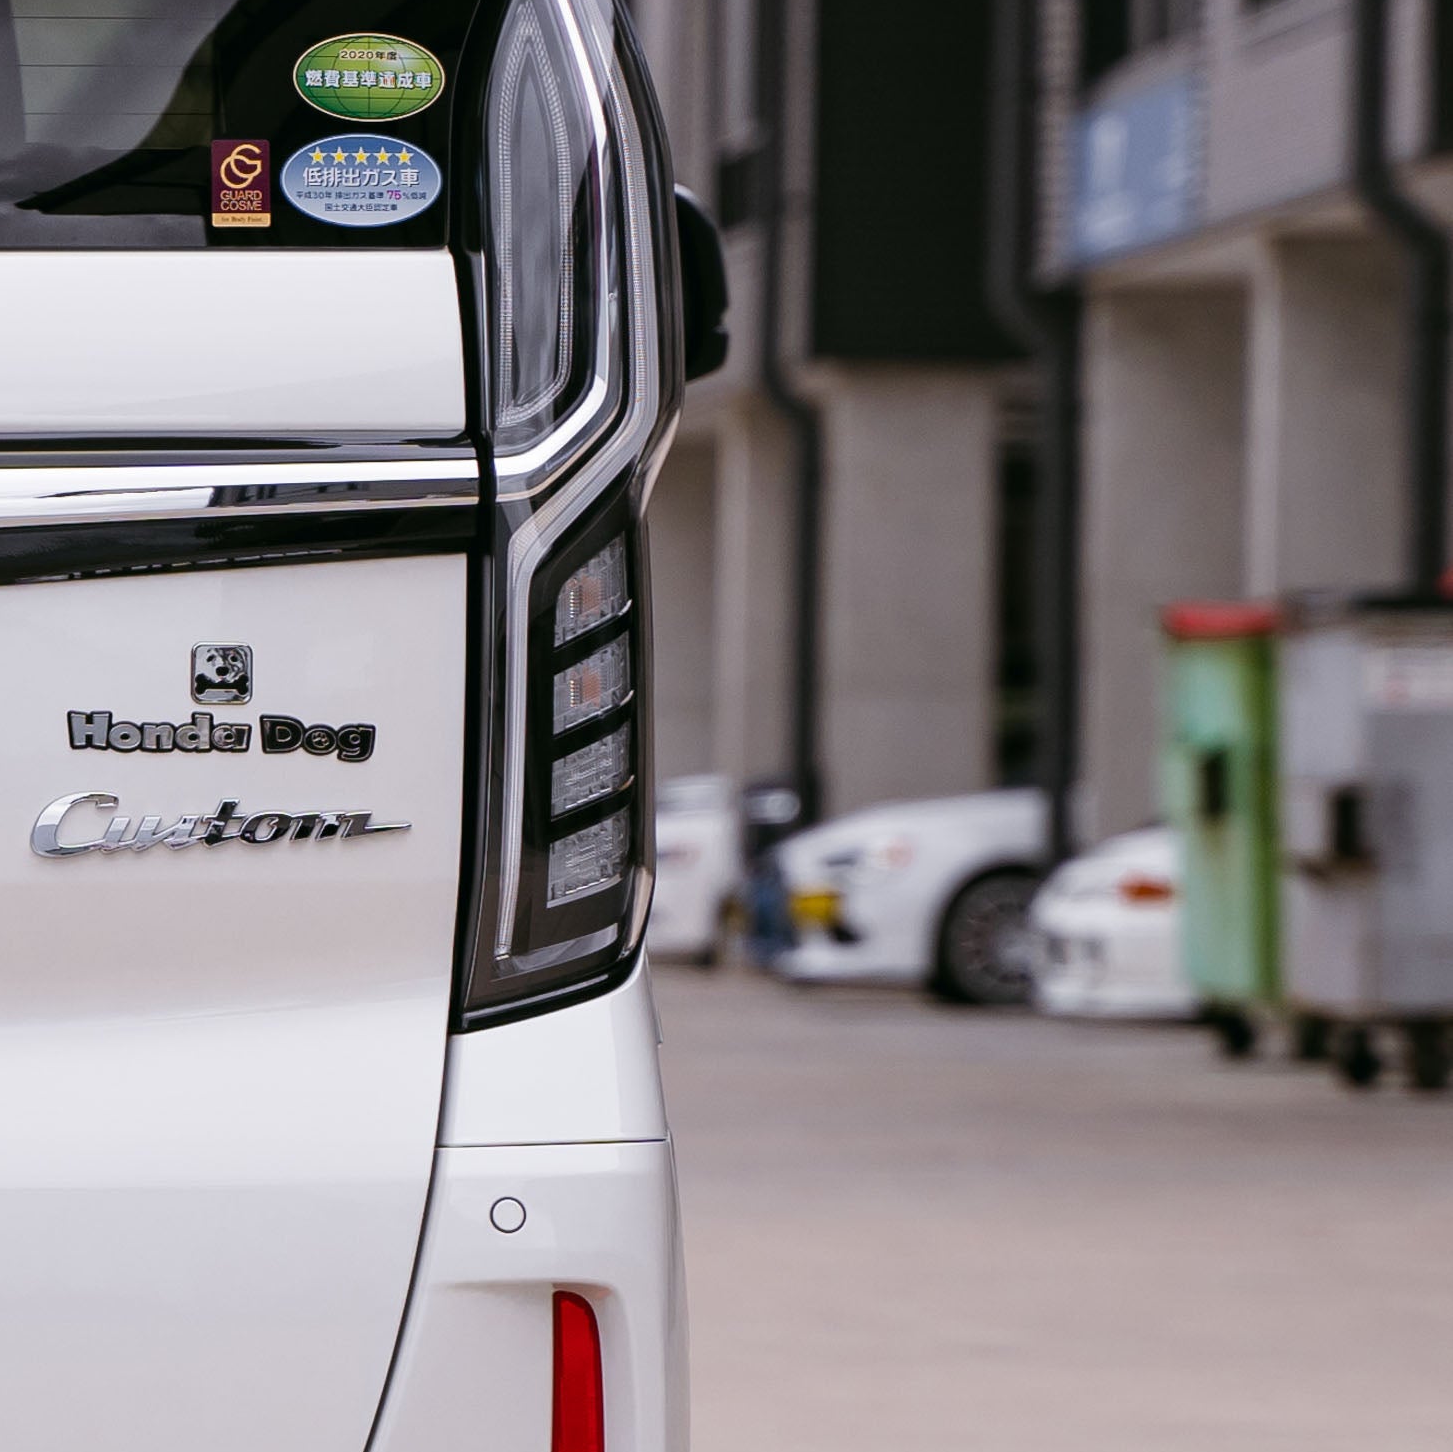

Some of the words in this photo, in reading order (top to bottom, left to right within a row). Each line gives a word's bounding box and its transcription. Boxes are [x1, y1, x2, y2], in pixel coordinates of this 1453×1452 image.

[340, 50, 398, 61] 2020年度
[305, 69, 433, 90] 燃費基準達成車
[303, 167, 420, 187] 低排出ガス車
[220, 190, 263, 200] GUARD
[220, 201, 263, 211] COSME
[67, 710, 252, 753] Honda
[259, 713, 377, 762] Dog
[30, 791, 413, 859] Custom
